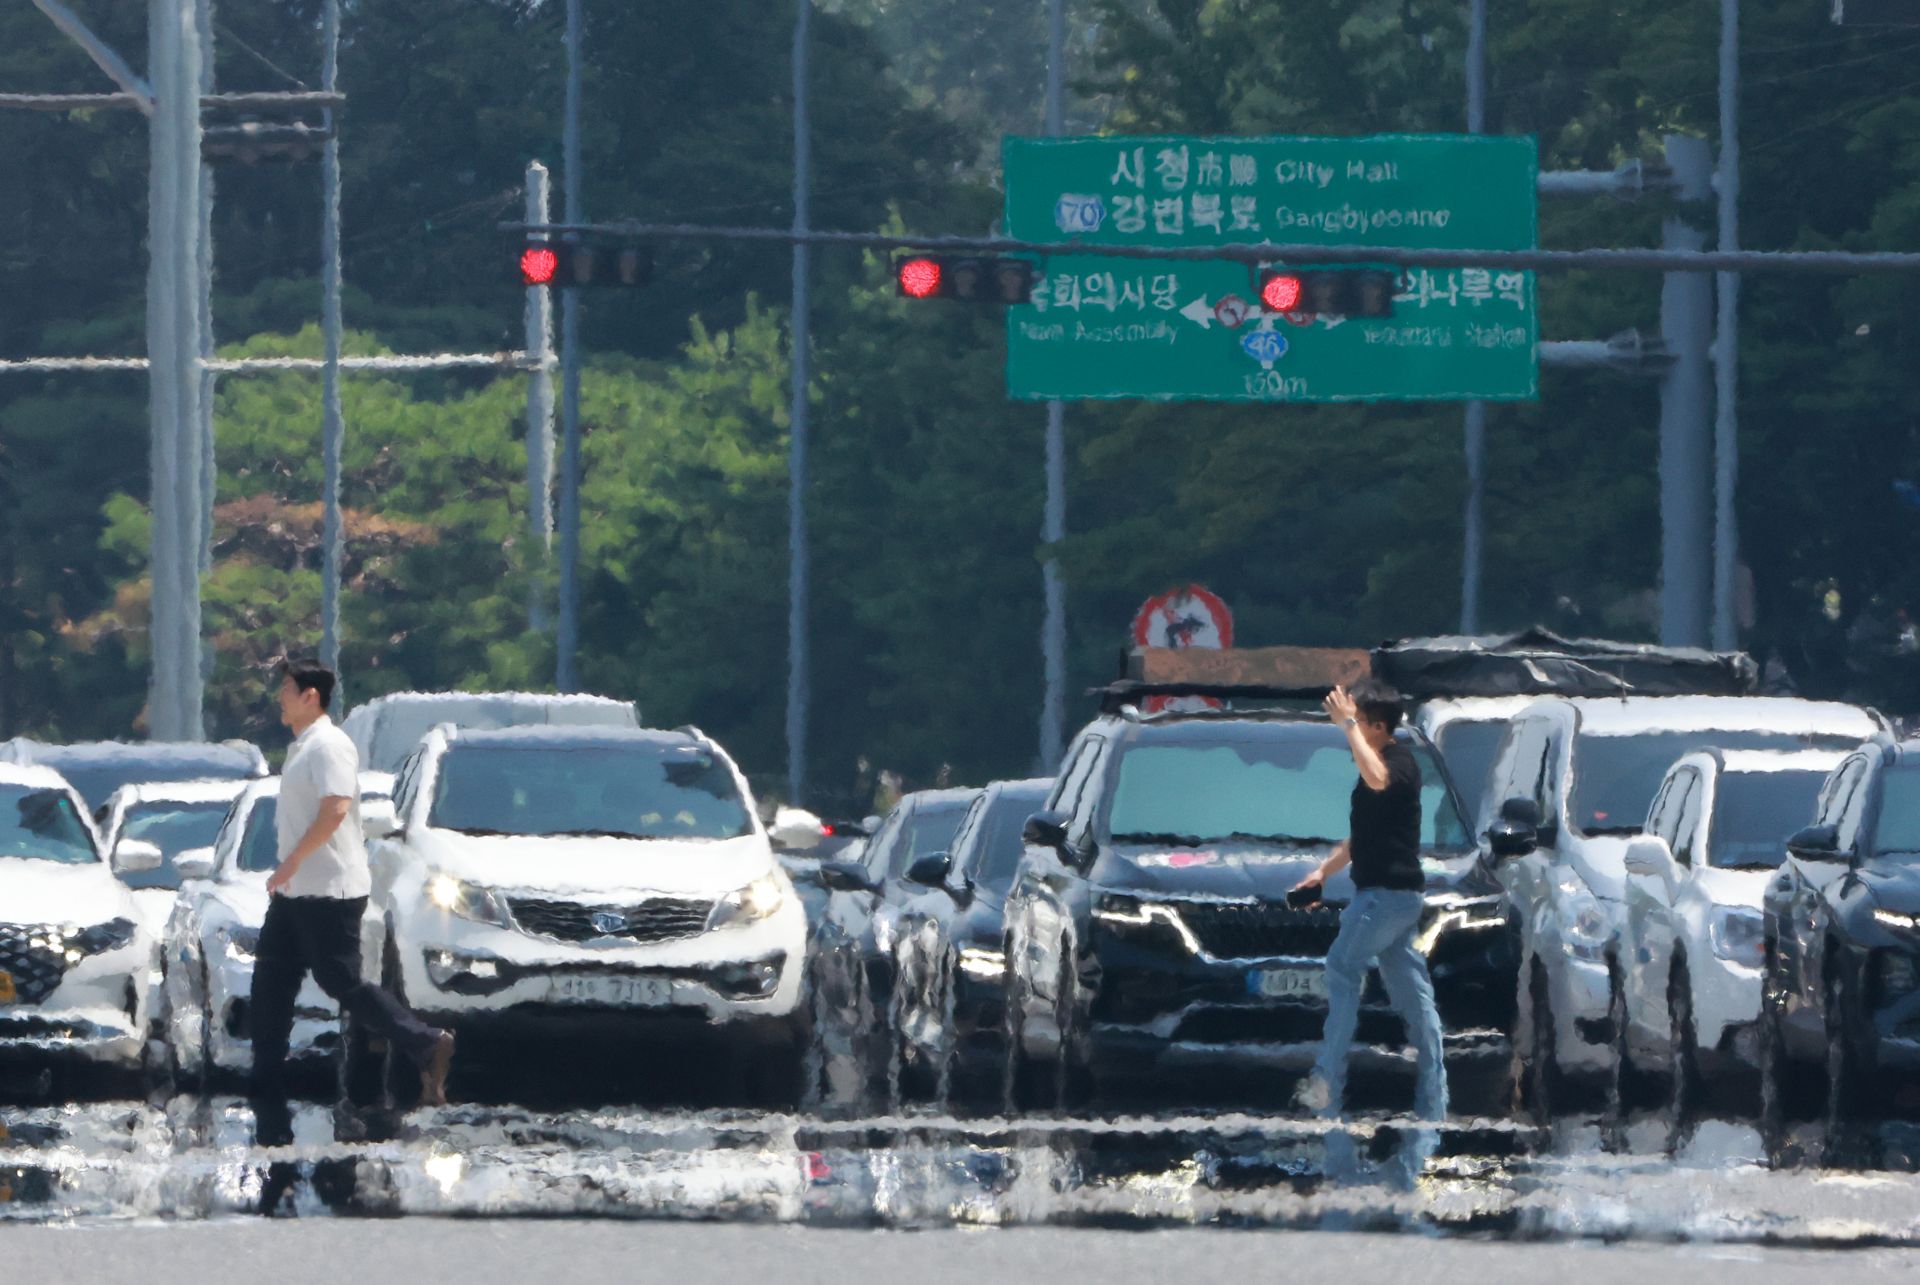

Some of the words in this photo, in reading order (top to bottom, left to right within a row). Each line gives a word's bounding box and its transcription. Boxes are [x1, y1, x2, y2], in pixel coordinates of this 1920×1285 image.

[1111, 145, 1188, 191] 시청
[1275, 160, 1334, 188] City
[1347, 160, 1398, 181] Hall
[1058, 200, 1098, 227] 70
[1111, 192, 1260, 234] 강변북로
[1391, 268, 1525, 310] 의나루역
[1247, 331, 1283, 353] 46
